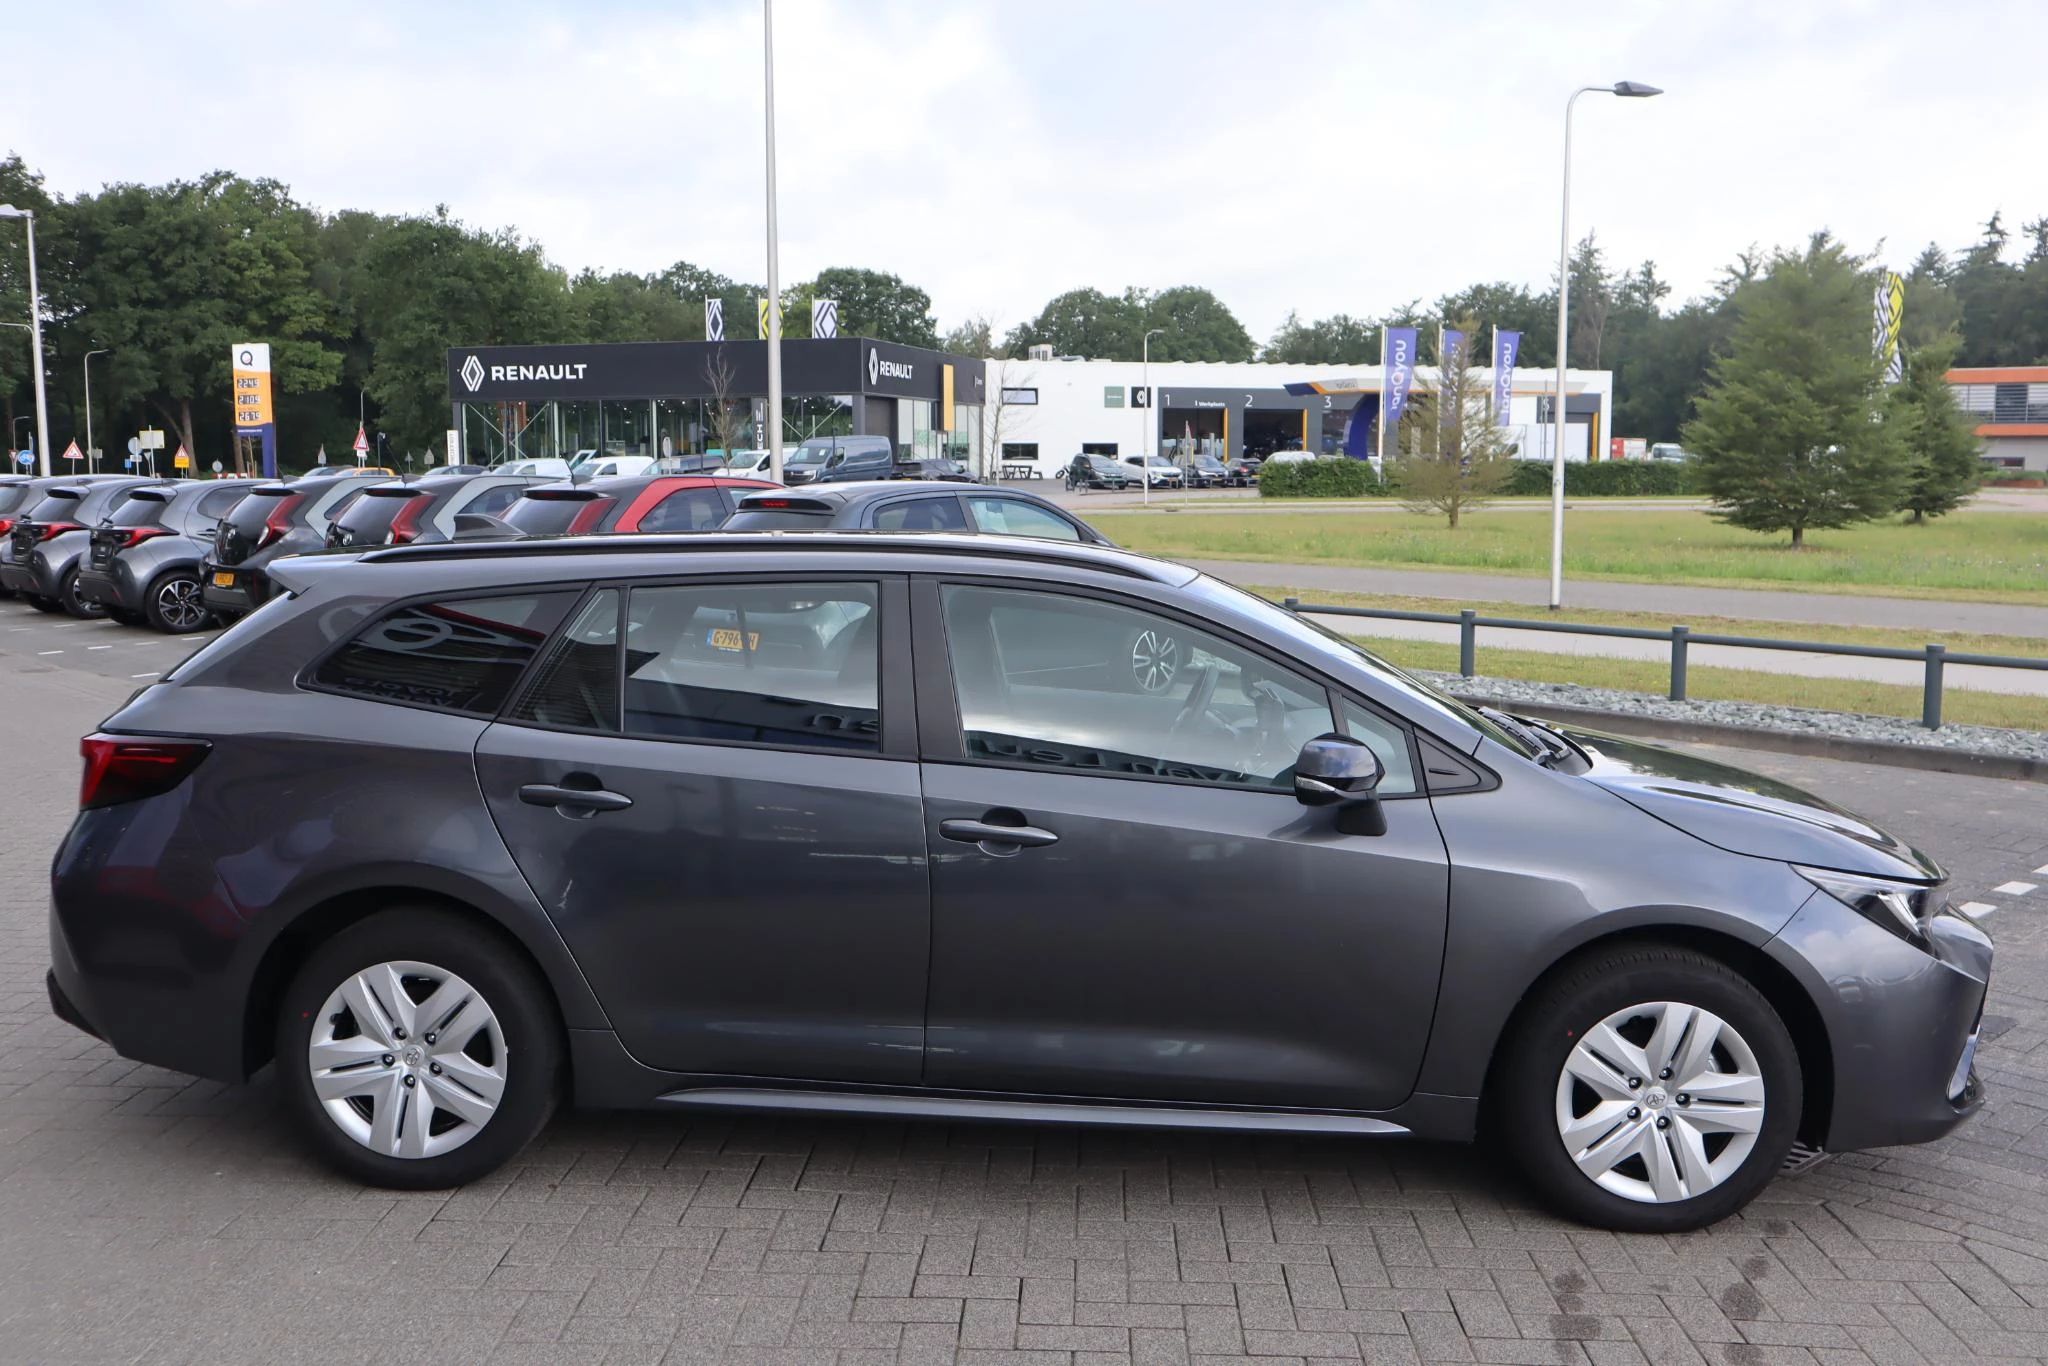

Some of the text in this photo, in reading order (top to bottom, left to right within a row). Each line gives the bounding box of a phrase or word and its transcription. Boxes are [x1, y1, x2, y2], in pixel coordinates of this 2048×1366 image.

[240, 350, 253, 366] Q
[491, 363, 587, 381] RENAULT
[880, 361, 913, 379] RENAULT
[1165, 394, 1170, 406] 1
[1245, 394, 1253, 407] 2
[1324, 395, 1332, 408] 3
